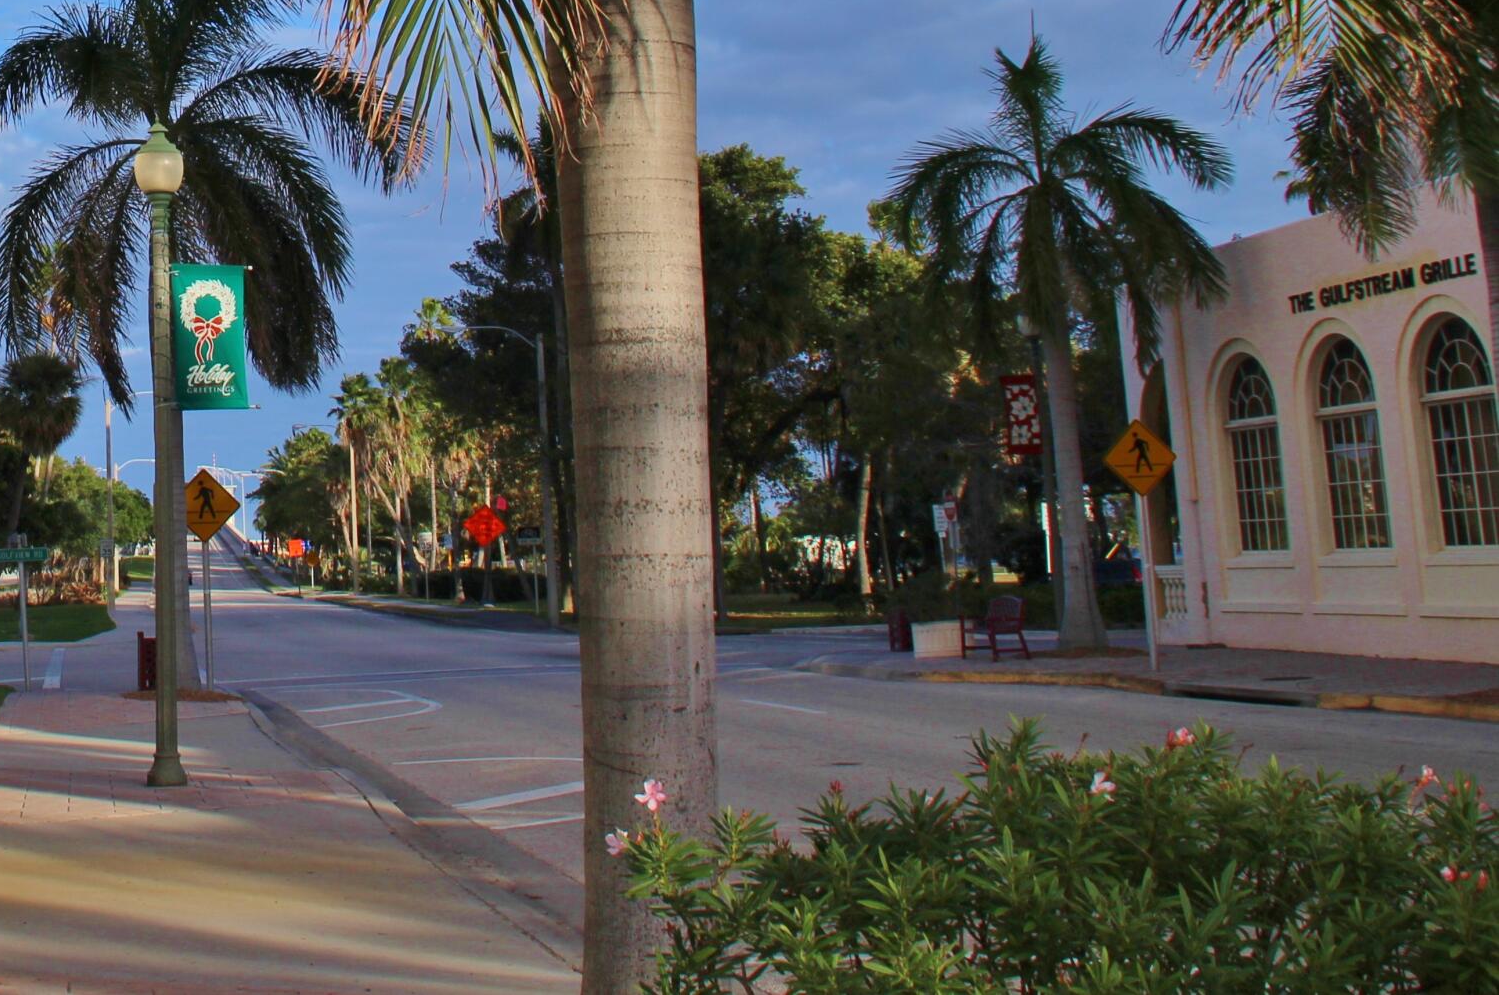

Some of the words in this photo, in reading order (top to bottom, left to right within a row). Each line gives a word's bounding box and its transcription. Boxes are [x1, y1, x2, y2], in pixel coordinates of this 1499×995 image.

[1288, 292, 1315, 314] THE
[1319, 267, 1415, 307] GULFSTREAM
[1420, 253, 1477, 284] GRILLE
[187, 363, 235, 396] Holiday
[187, 386, 235, 394] GREETINGS
